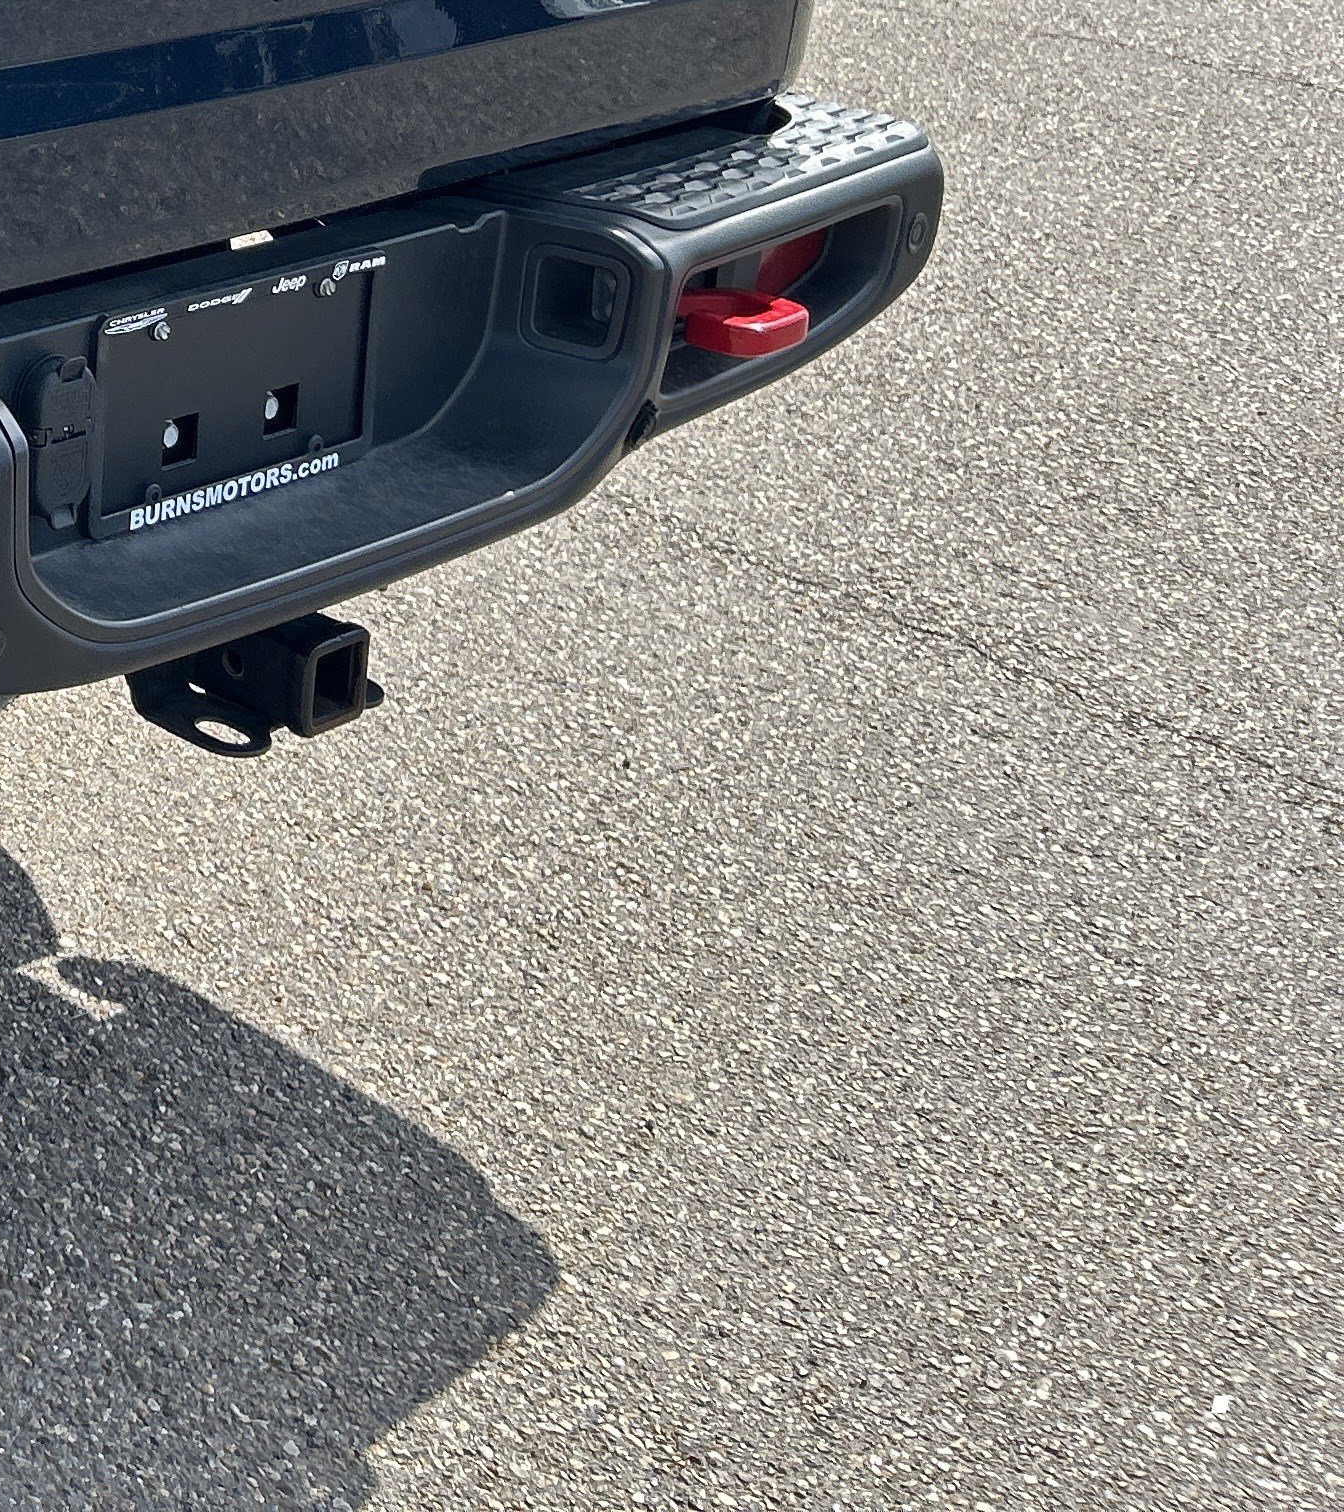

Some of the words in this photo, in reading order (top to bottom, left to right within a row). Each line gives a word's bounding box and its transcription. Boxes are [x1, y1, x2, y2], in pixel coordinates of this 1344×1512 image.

[108, 306, 166, 327] CHRYSLER
[272, 274, 307, 294] Jeep
[348, 255, 386, 273] RAM
[129, 451, 340, 531] BURNSMOTORS.com
